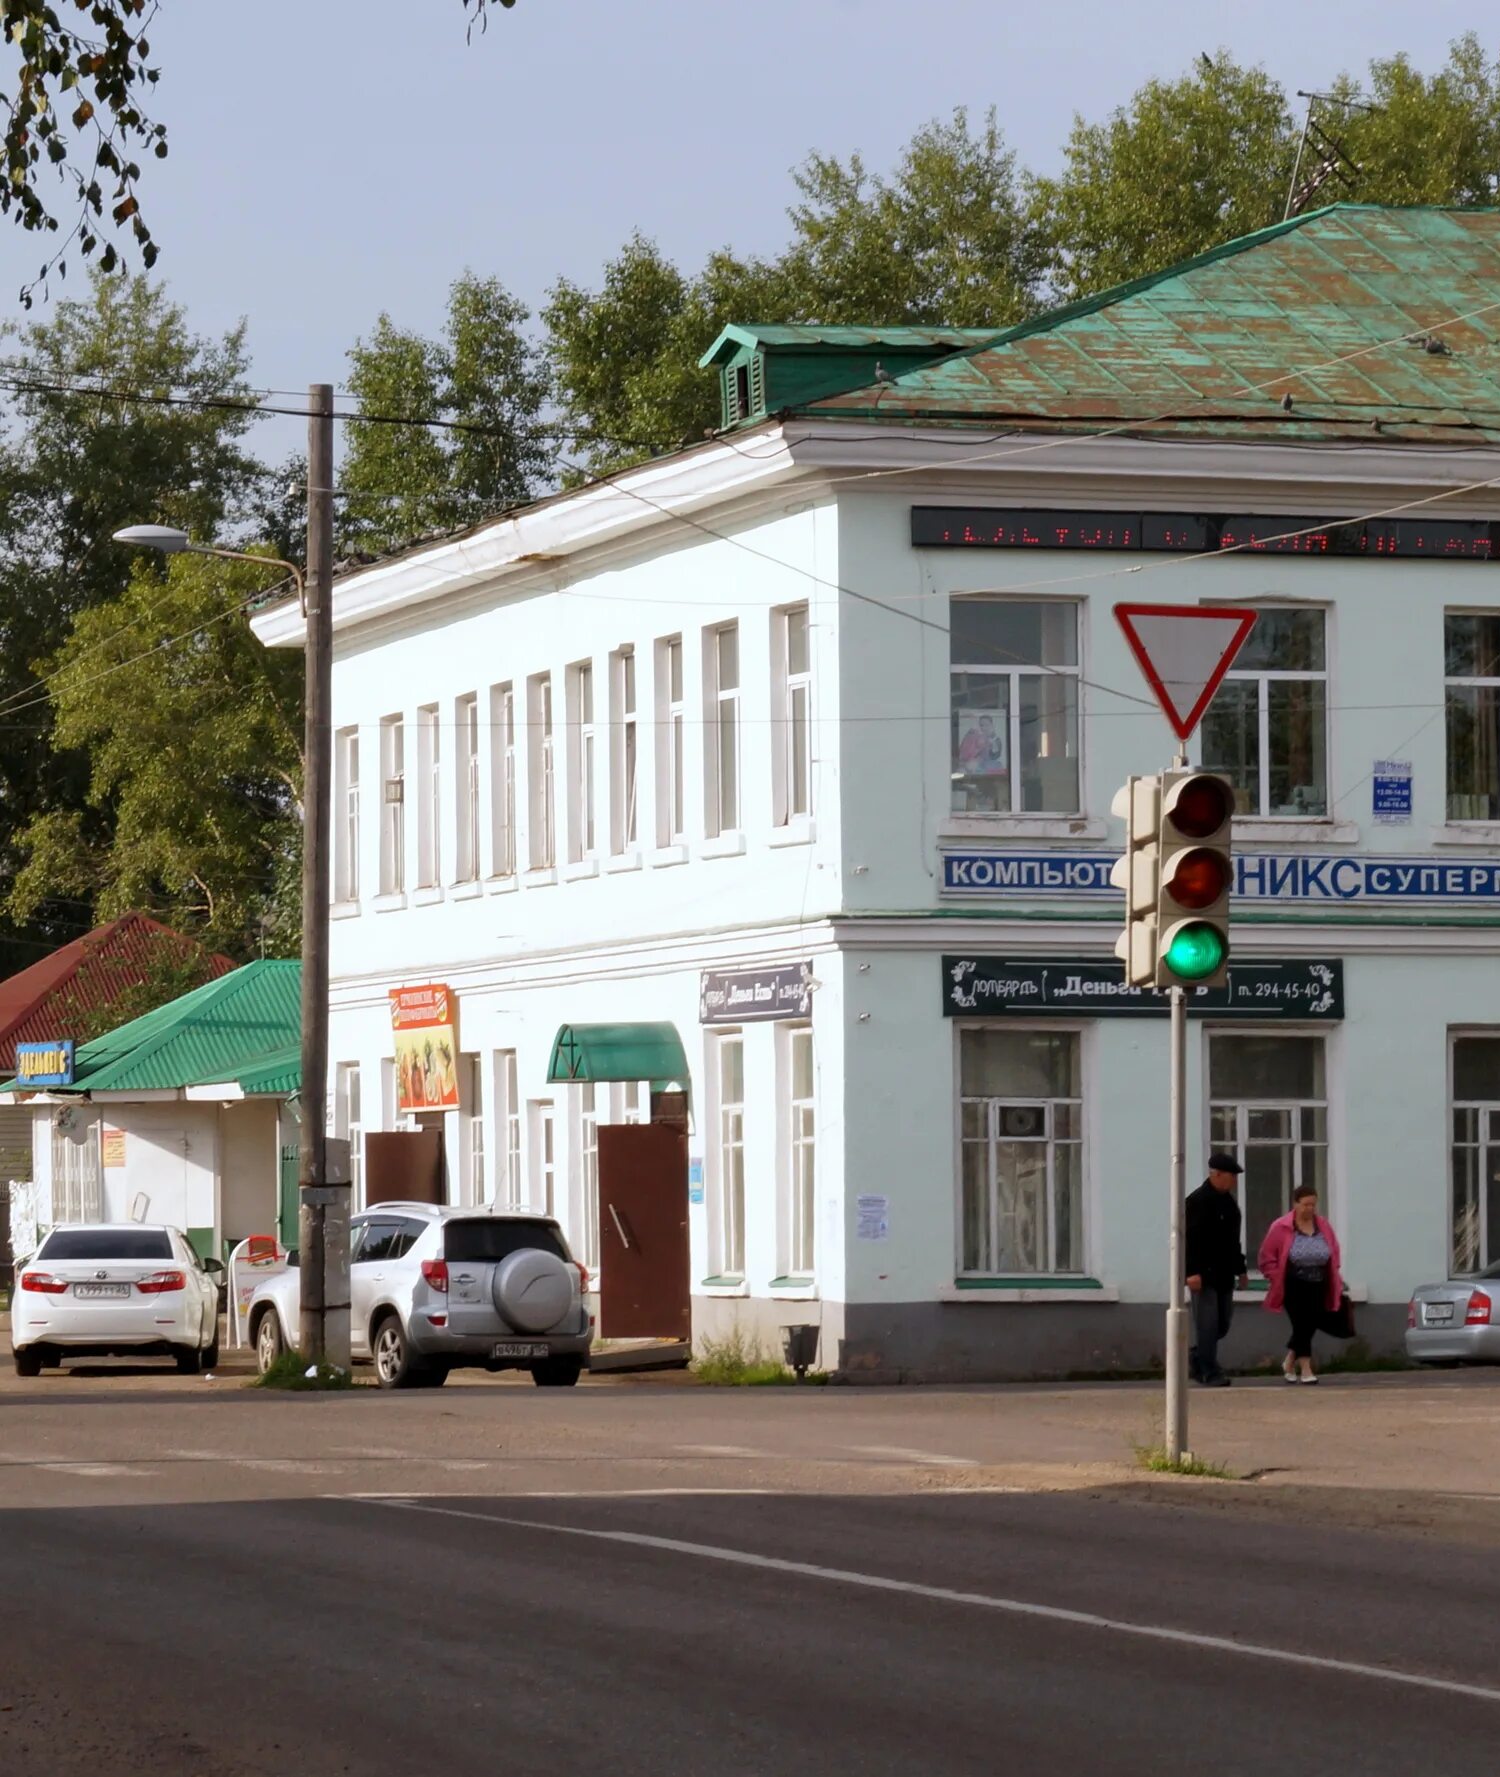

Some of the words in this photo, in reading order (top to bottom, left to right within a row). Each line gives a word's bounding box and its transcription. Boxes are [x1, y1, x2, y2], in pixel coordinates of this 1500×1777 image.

[951, 860, 1114, 887] КОМПЬЮТ
[1237, 857, 1361, 898] НИКС
[1255, 982, 1320, 998] 294-45-40
